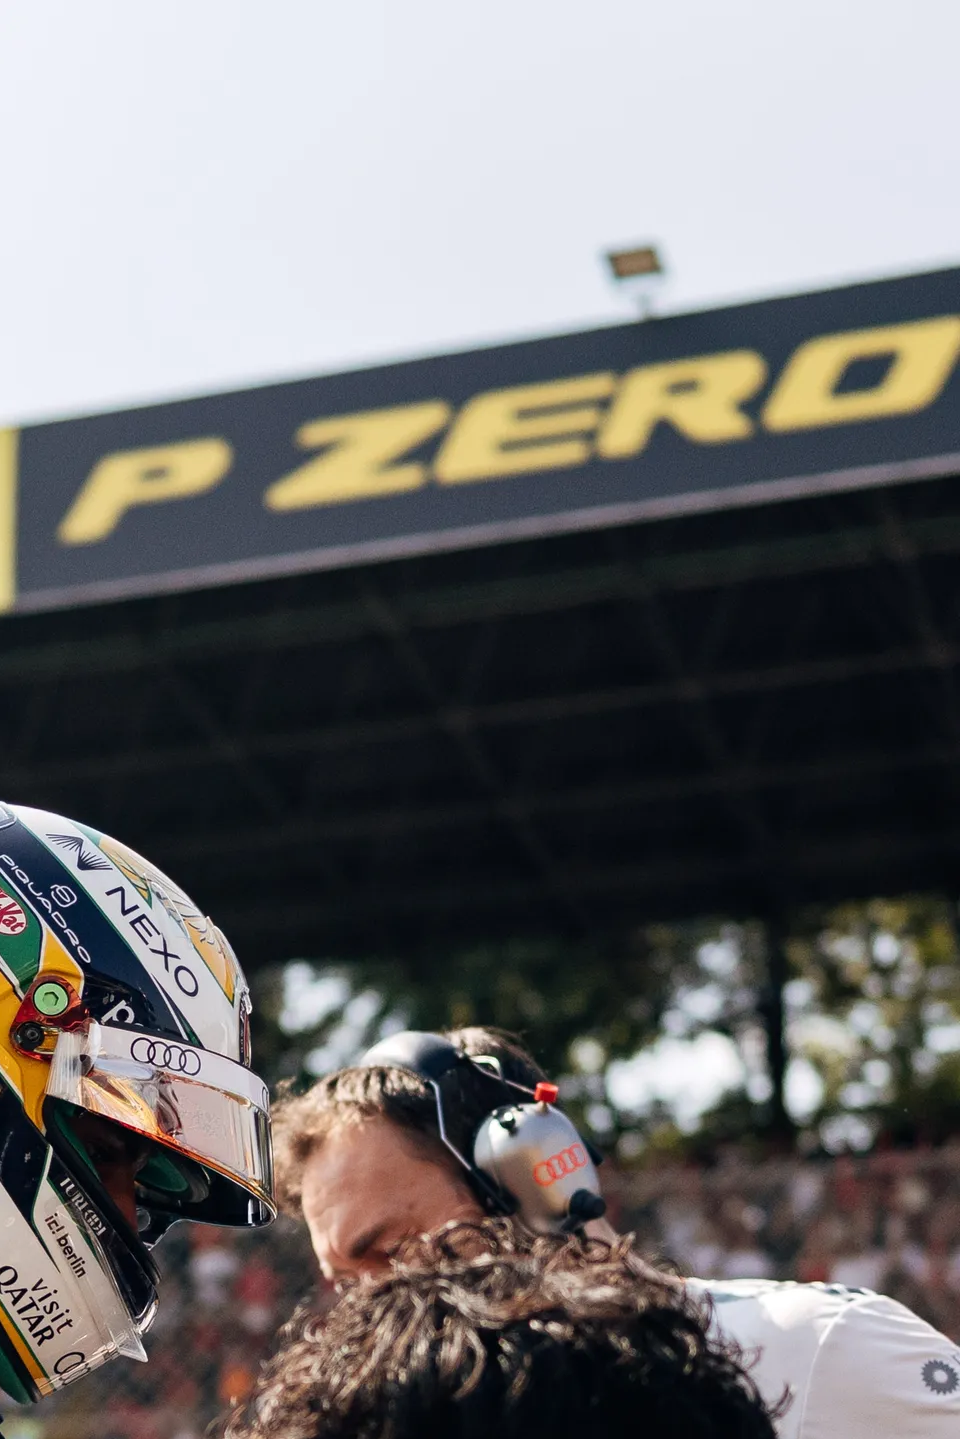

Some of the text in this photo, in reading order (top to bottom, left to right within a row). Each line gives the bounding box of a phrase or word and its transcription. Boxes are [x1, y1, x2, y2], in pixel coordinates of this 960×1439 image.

[55, 313, 960, 545] P ZERO
[105, 885, 200, 998] NEXO
[56, 1232, 87, 1279] berlin
[30, 1277, 74, 1335] visit
